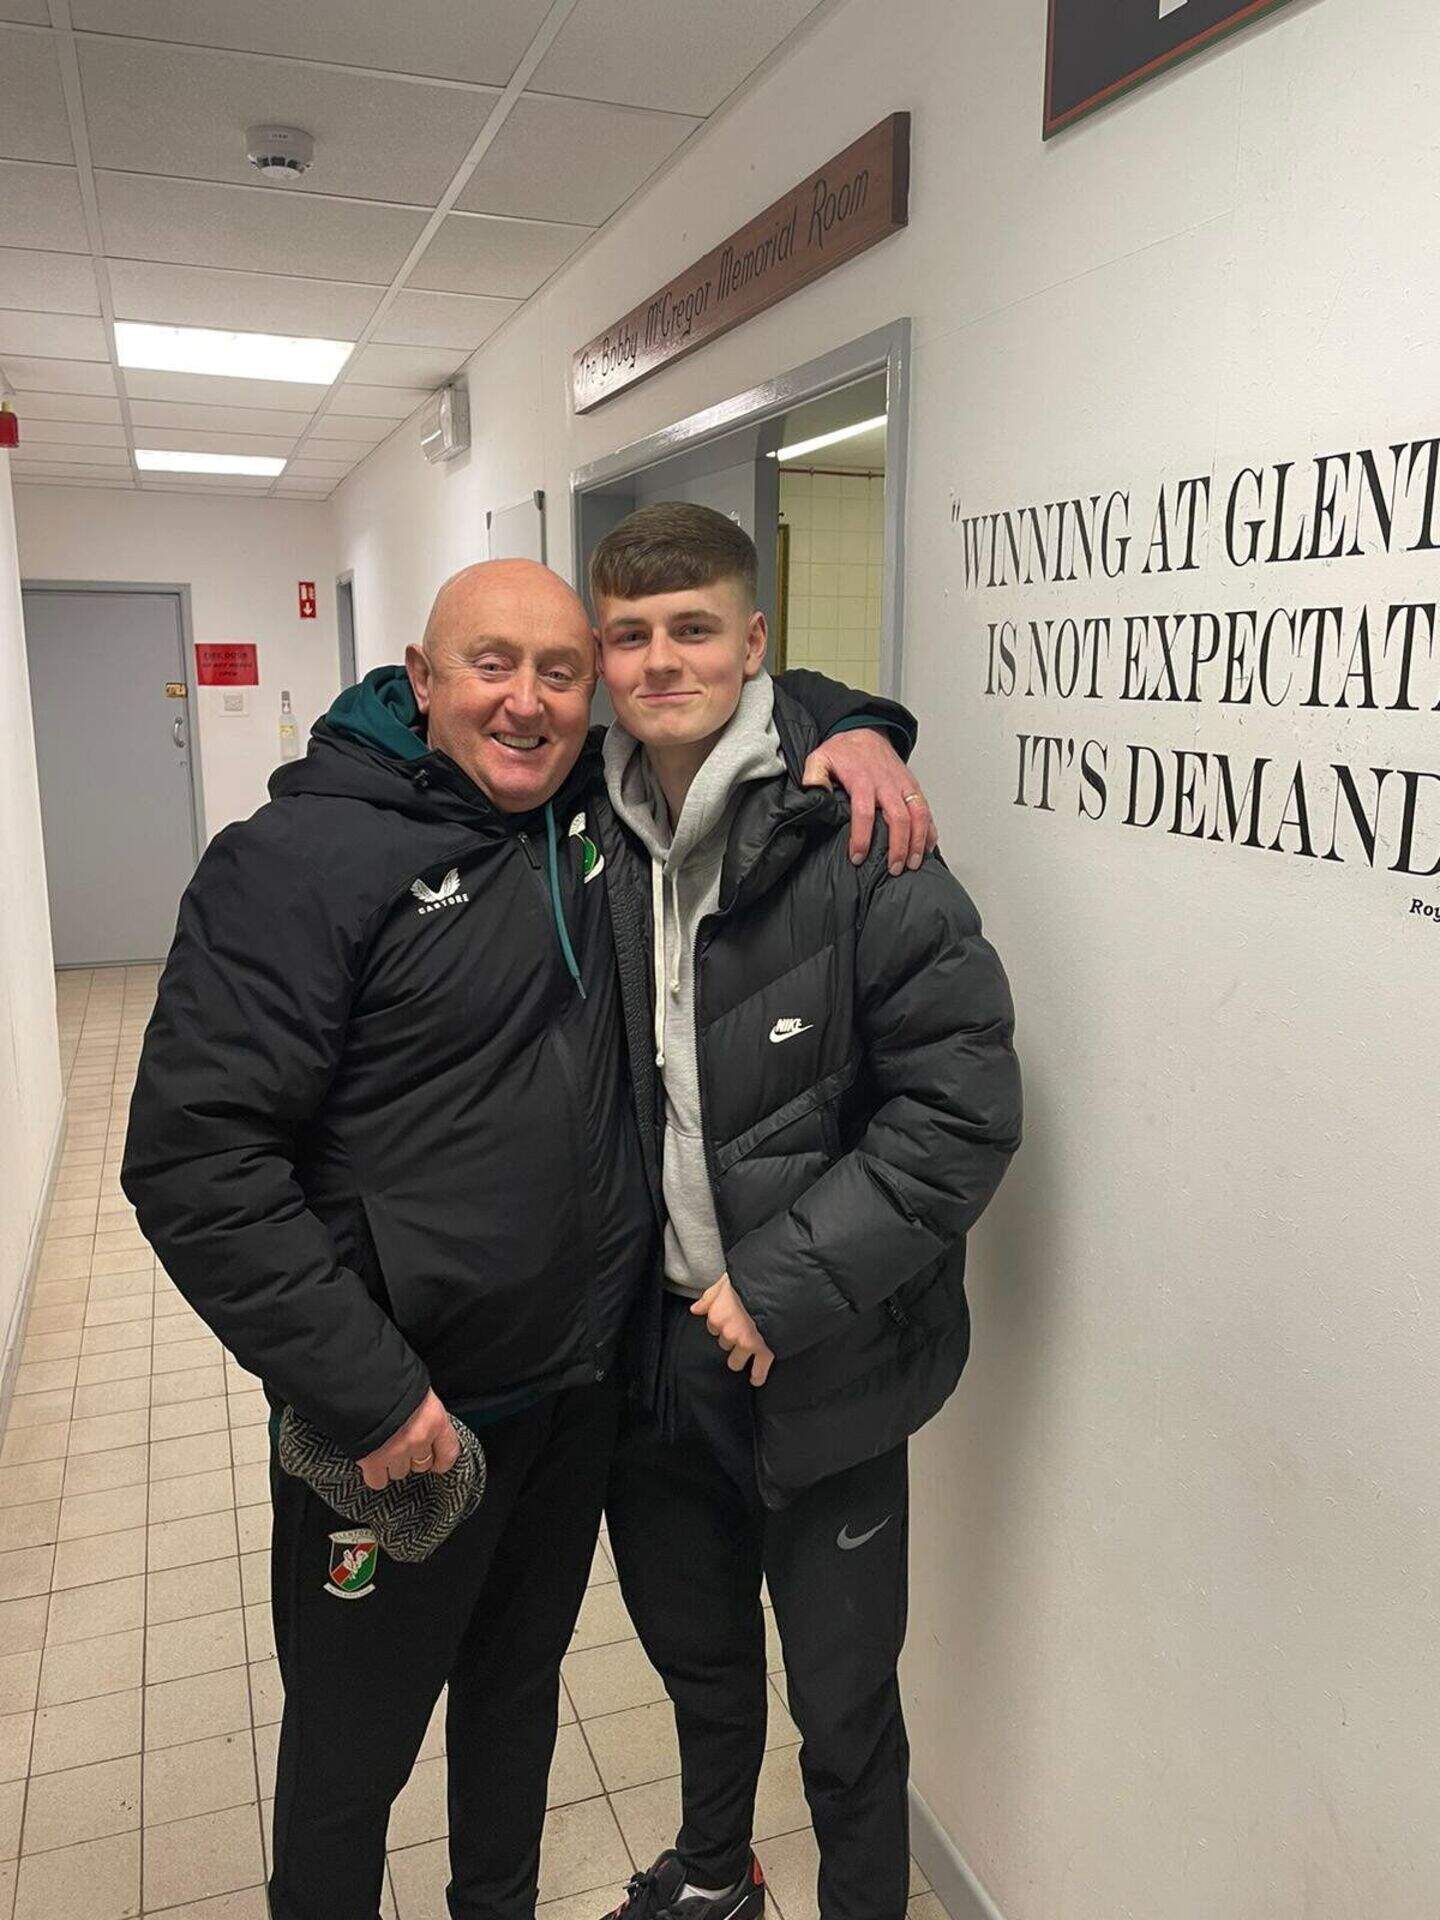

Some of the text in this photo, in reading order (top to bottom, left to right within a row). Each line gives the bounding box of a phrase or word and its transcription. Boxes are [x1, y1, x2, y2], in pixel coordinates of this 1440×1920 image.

[716, 205, 799, 303] Memorial
[807, 169, 870, 251] Room
[1141, 475, 1211, 574] AT
[984, 602, 1440, 712] IS NOT EXPECTAT
[1013, 734, 1109, 821] IT'S
[418, 893, 469, 915] CASTORE
[775, 1018, 802, 1033] NIKE
